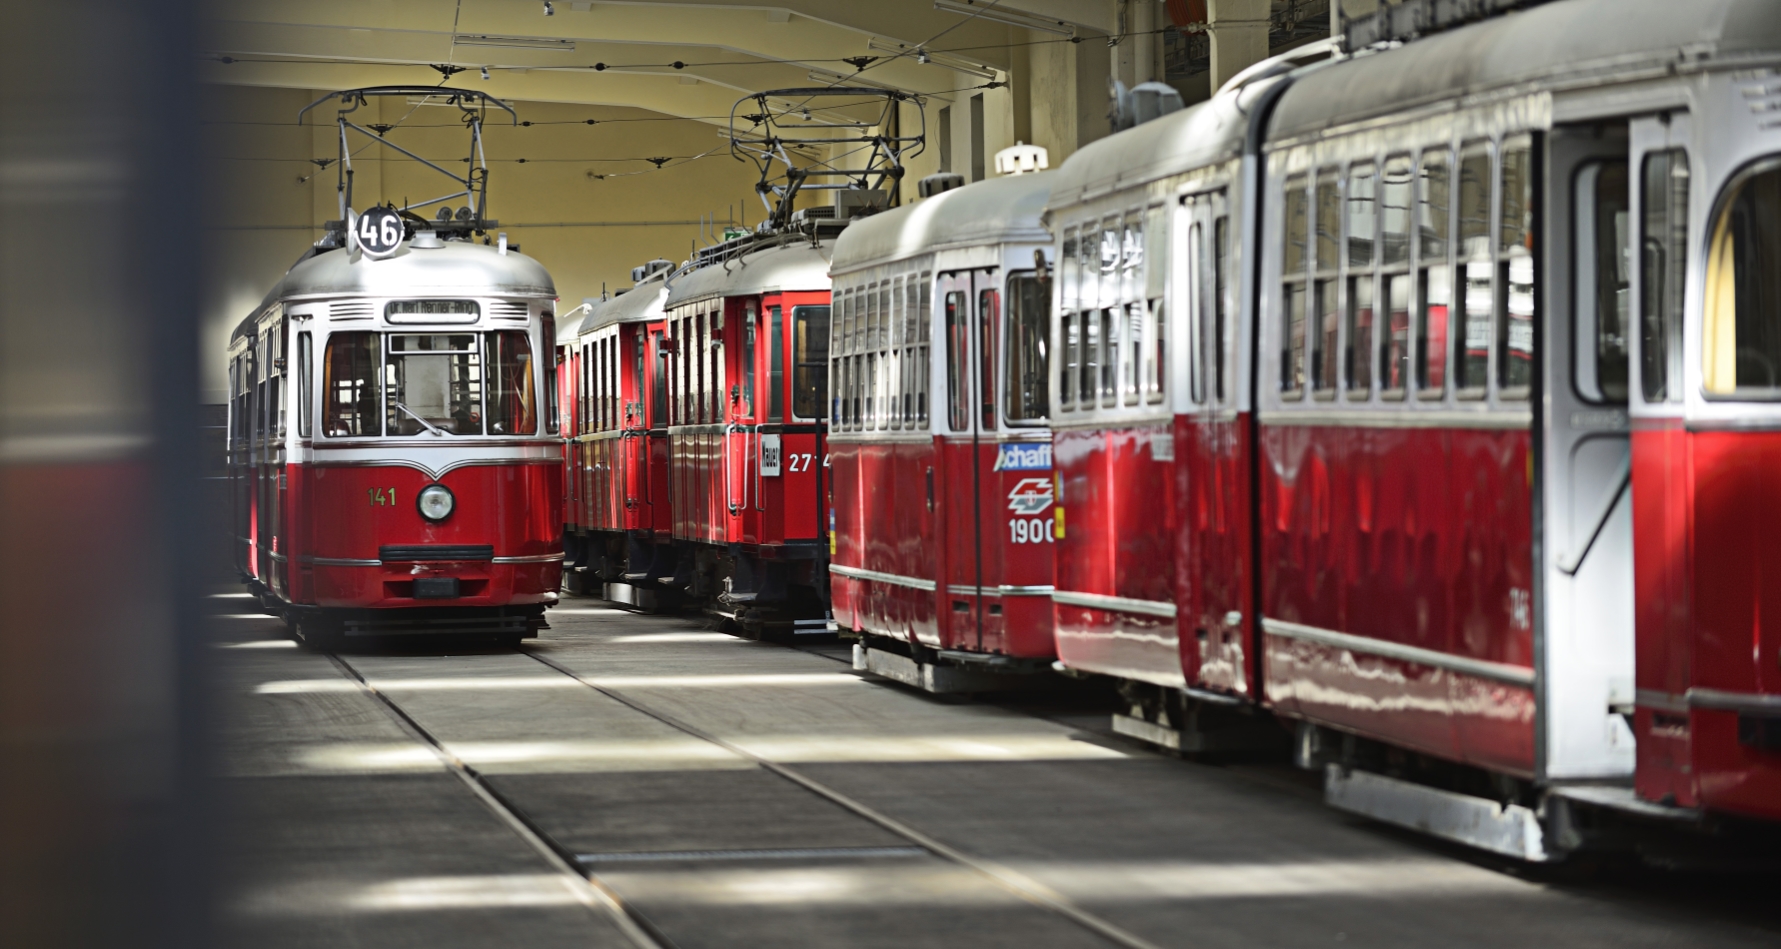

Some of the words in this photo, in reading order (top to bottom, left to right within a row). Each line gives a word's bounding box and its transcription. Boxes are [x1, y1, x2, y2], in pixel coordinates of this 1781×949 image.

[361, 215, 397, 246] 46
[789, 453, 830, 472] 274
[367, 487, 396, 506] 141
